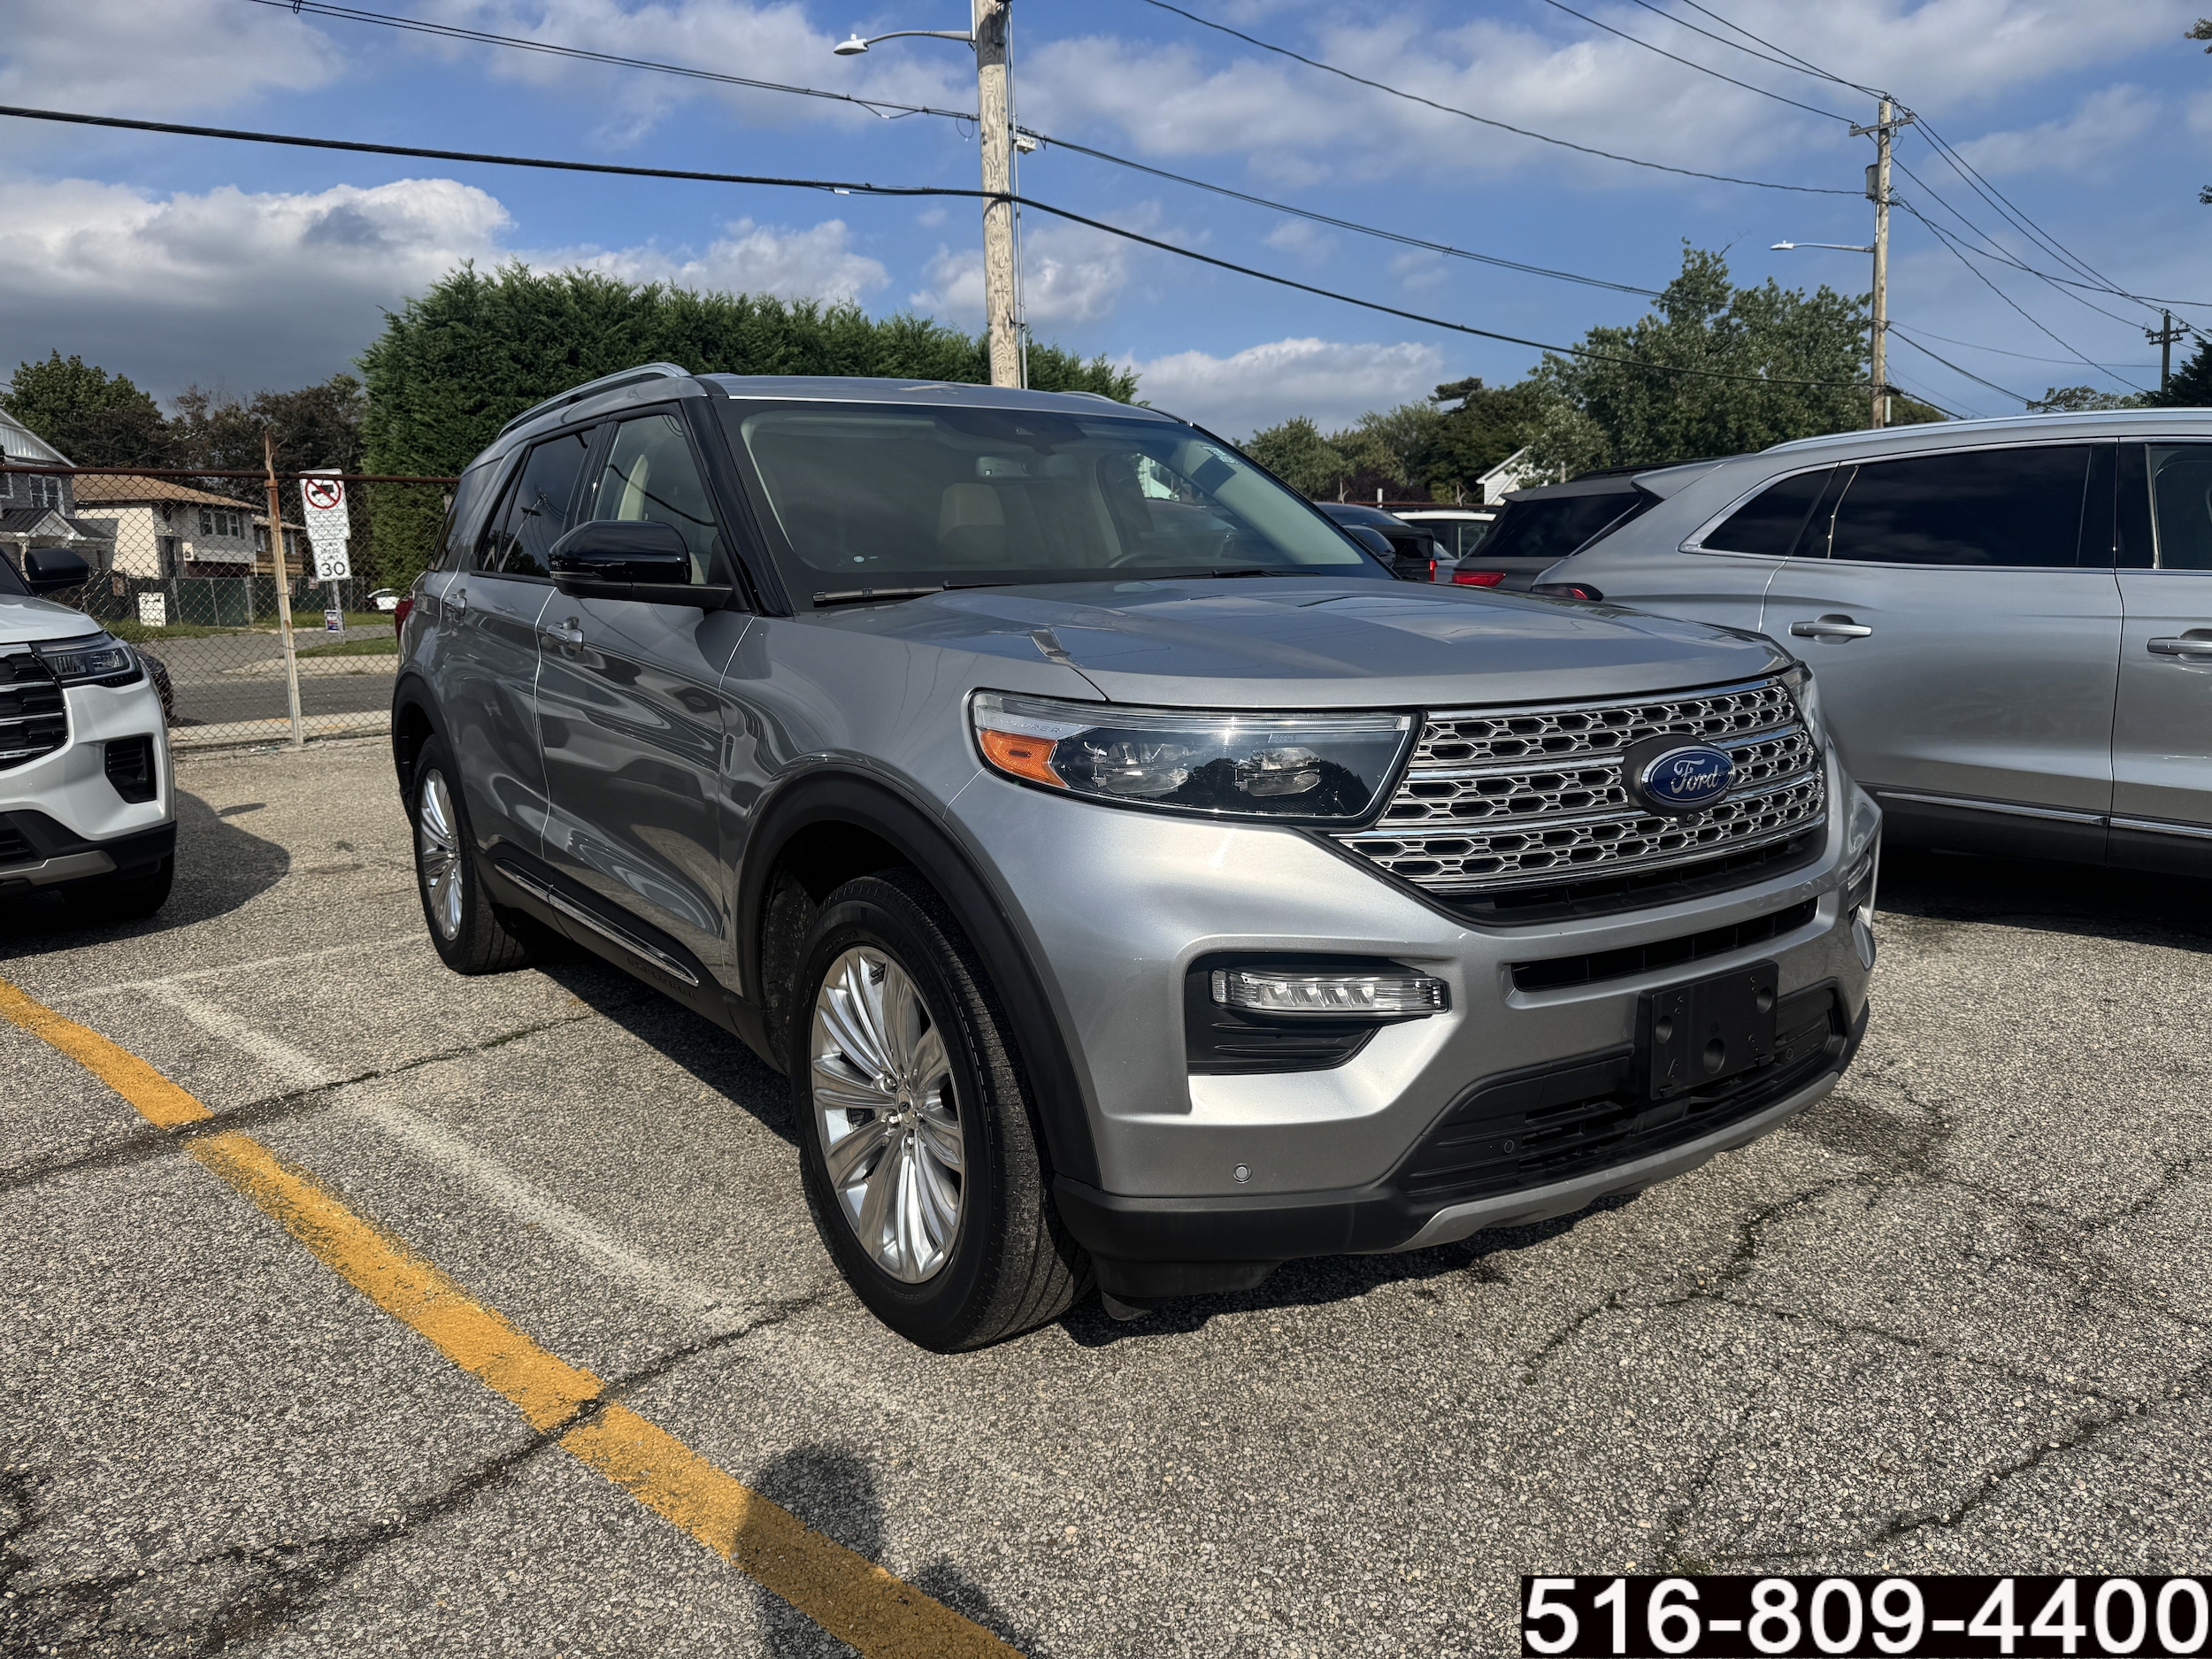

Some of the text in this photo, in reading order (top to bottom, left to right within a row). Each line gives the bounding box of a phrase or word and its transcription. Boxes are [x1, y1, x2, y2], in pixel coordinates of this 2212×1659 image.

[320, 561, 346, 577] 30
[987, 717, 1062, 734] EXPLORER
[1671, 758, 1719, 795] Ford
